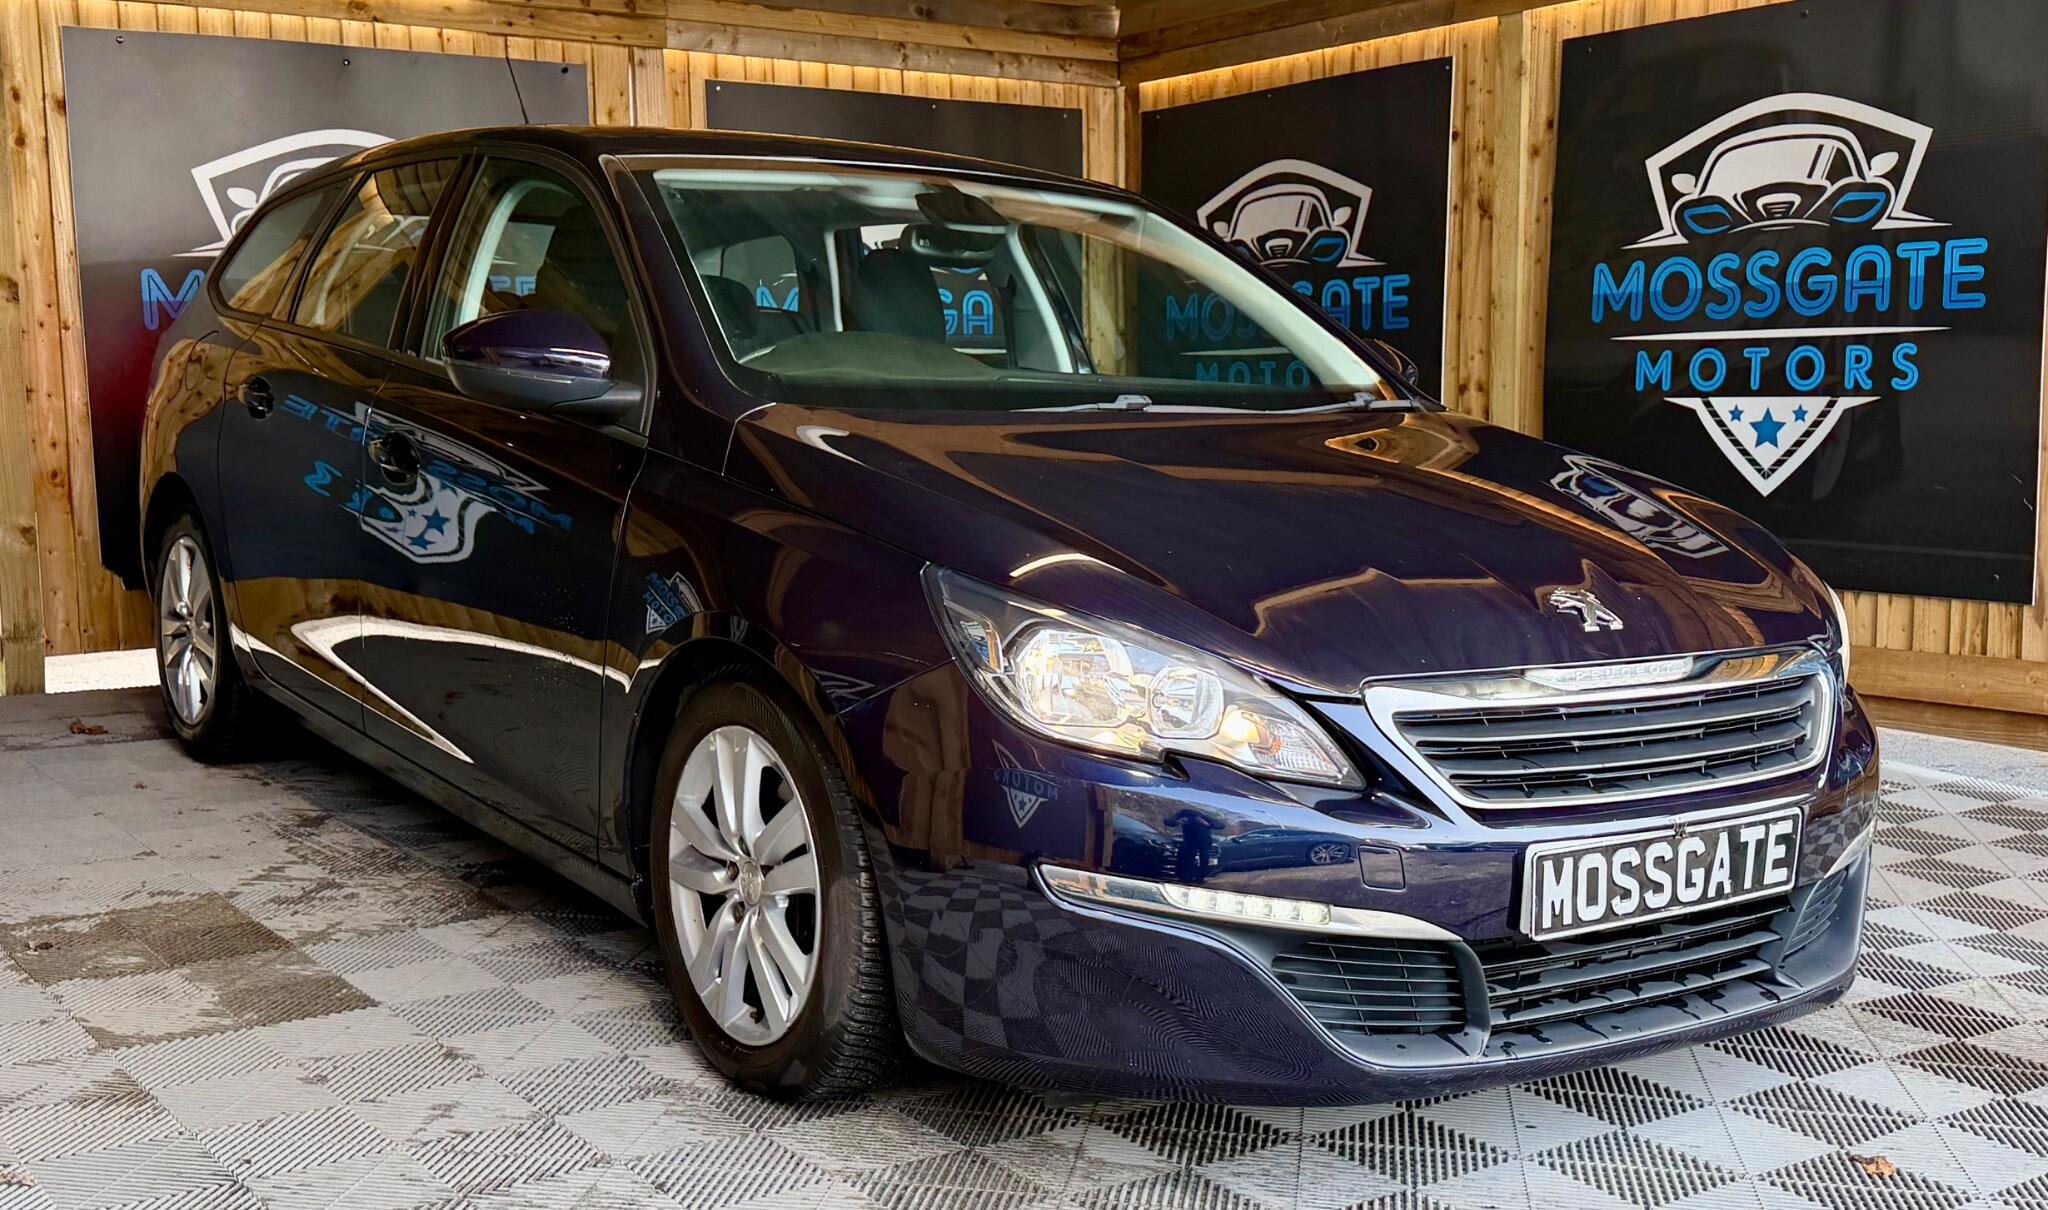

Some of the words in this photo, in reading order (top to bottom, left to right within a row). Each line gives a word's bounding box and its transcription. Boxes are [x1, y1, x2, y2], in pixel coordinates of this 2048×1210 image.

[1166, 273, 1410, 342] MOATE
[1591, 237, 1989, 324] MOSSGATE
[1196, 361, 1312, 392] MOTO
[1635, 342, 1920, 392] MOTORS
[1575, 664, 1674, 682] PEUGEOT
[1541, 820, 1795, 929] MOSSGATE
